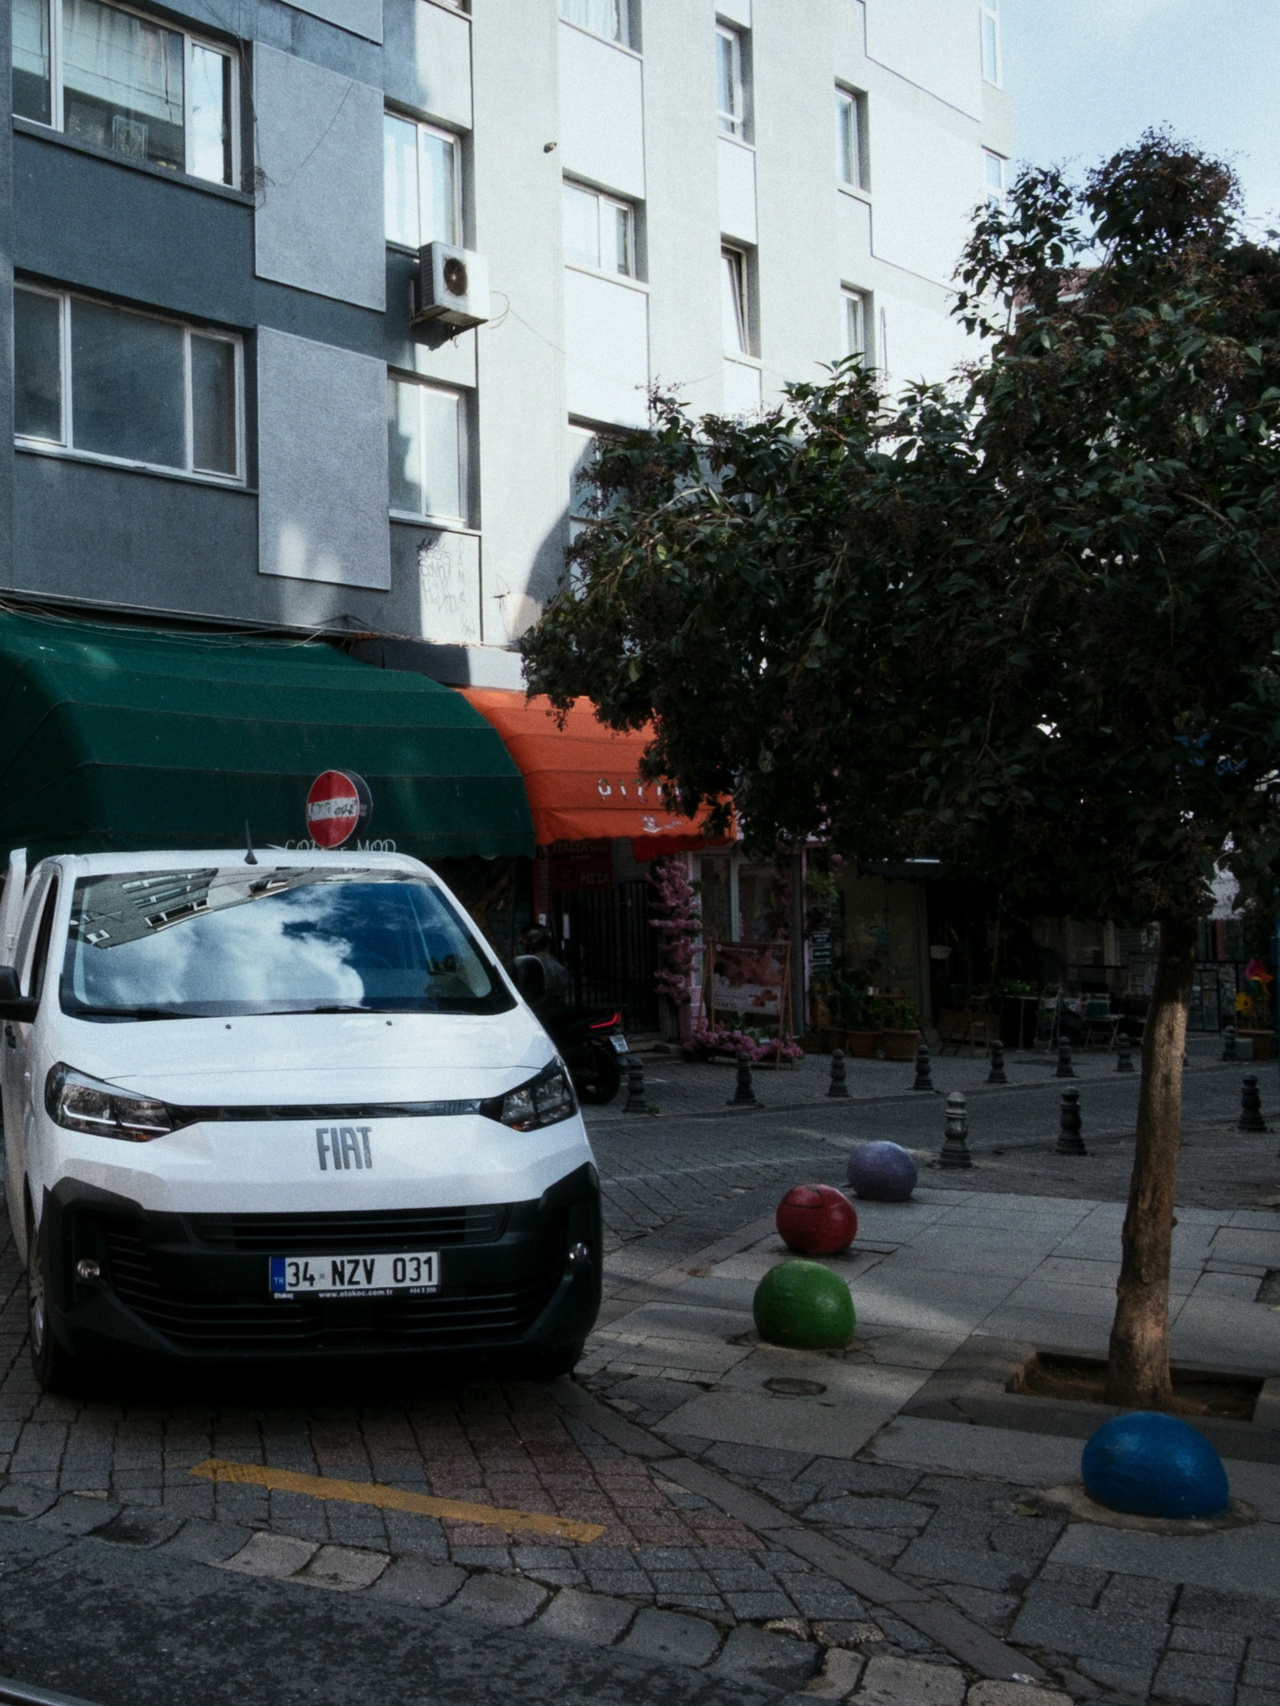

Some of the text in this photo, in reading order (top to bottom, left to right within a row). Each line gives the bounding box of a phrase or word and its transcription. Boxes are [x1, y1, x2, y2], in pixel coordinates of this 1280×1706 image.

[316, 1126, 372, 1171] FIAT
[273, 1276, 285, 1285] TR
[287, 1256, 433, 1287] 34 NZV 031
[318, 1289, 394, 1299] www.otokoc.com.tr
